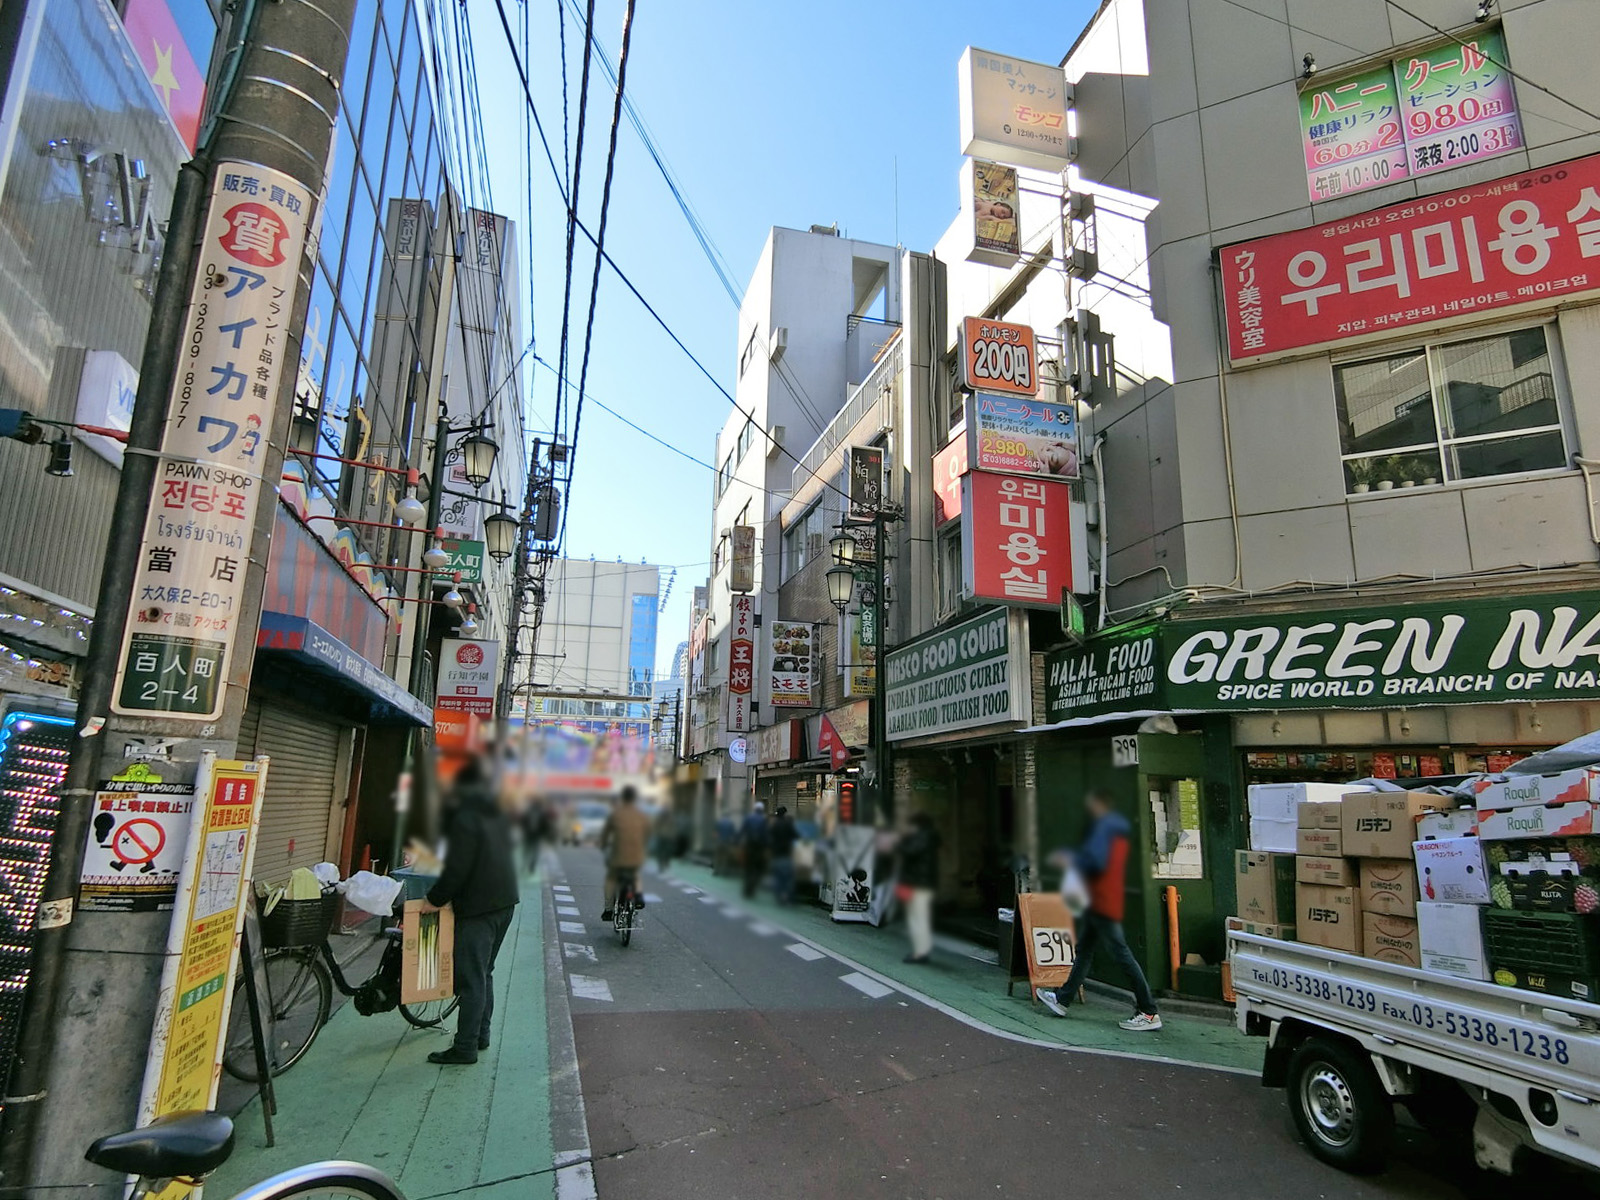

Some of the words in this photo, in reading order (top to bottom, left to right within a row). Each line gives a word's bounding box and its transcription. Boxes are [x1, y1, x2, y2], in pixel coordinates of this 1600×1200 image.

[1006, 77, 1057, 99] マッサージ
[1309, 82, 1388, 120] ハニー
[1404, 40, 1489, 93] クール
[1014, 104, 1065, 128] モッコ
[1308, 104, 1394, 140] 健康リラク
[1407, 72, 1500, 109] ゼーション
[1409, 96, 1504, 136] 980円
[1313, 139, 1371, 165] 60分
[1377, 121, 1401, 149] 2
[1482, 122, 1516, 151] 3F
[222, 173, 303, 216] 販売・買取
[230, 210, 281, 263] 質
[1233, 249, 1267, 351] ウリ美容室
[176, 263, 217, 429] 03-3209-8877
[979, 323, 1021, 343] ホルモン
[197, 266, 267, 454] アイカワ
[973, 338, 1031, 389] 200円
[980, 399, 1055, 424] ハニークール
[1057, 410, 1071, 425] 3F
[165, 462, 210, 481] PAWN
[212, 470, 253, 490] SHOP
[868, 455, 881, 463] 301
[161, 479, 247, 521] 전당포
[157, 514, 243, 550] โรงรับจำนำ
[141, 585, 233, 612] 大久保2-20-1
[861, 603, 873, 644] 人町文化通り
[135, 651, 217, 678] 百人町
[887, 652, 920, 686] NASCO
[922, 637, 957, 673] FOOD
[959, 616, 1007, 659] COURT
[1050, 654, 1097, 687] HALAL
[1106, 637, 1154, 674] FOOD
[1166, 614, 1467, 686] GREEN
[140, 681, 199, 705] 2-4
[780, 678, 810, 690] モモ
[887, 688, 917, 713] INDIAN
[917, 672, 967, 704] DELICIOUS
[970, 659, 1008, 692] CURRY
[1051, 693, 1098, 712] INTERNATIONAL
[1100, 685, 1132, 703] CALLING
[1133, 682, 1154, 697] CARD
[1058, 682, 1083, 700] ASIAN
[1086, 673, 1126, 695] AFRICAN
[1127, 664, 1155, 687] FOOD
[1216, 682, 1282, 701] SPICE
[1289, 678, 1375, 700] WORLD
[1382, 674, 1493, 696] BRANCH
[1504, 672, 1545, 690] OF
[1554, 669, 1600, 689] NA
[887, 707, 919, 735] ARABIAN
[941, 695, 981, 724] TURKISH
[982, 689, 1009, 717] FOOD
[1503, 785, 1540, 802] Roquin
[1507, 816, 1544, 833] Roquin
[1541, 890, 1563, 899] RUTA
[1035, 931, 1075, 963] 399
